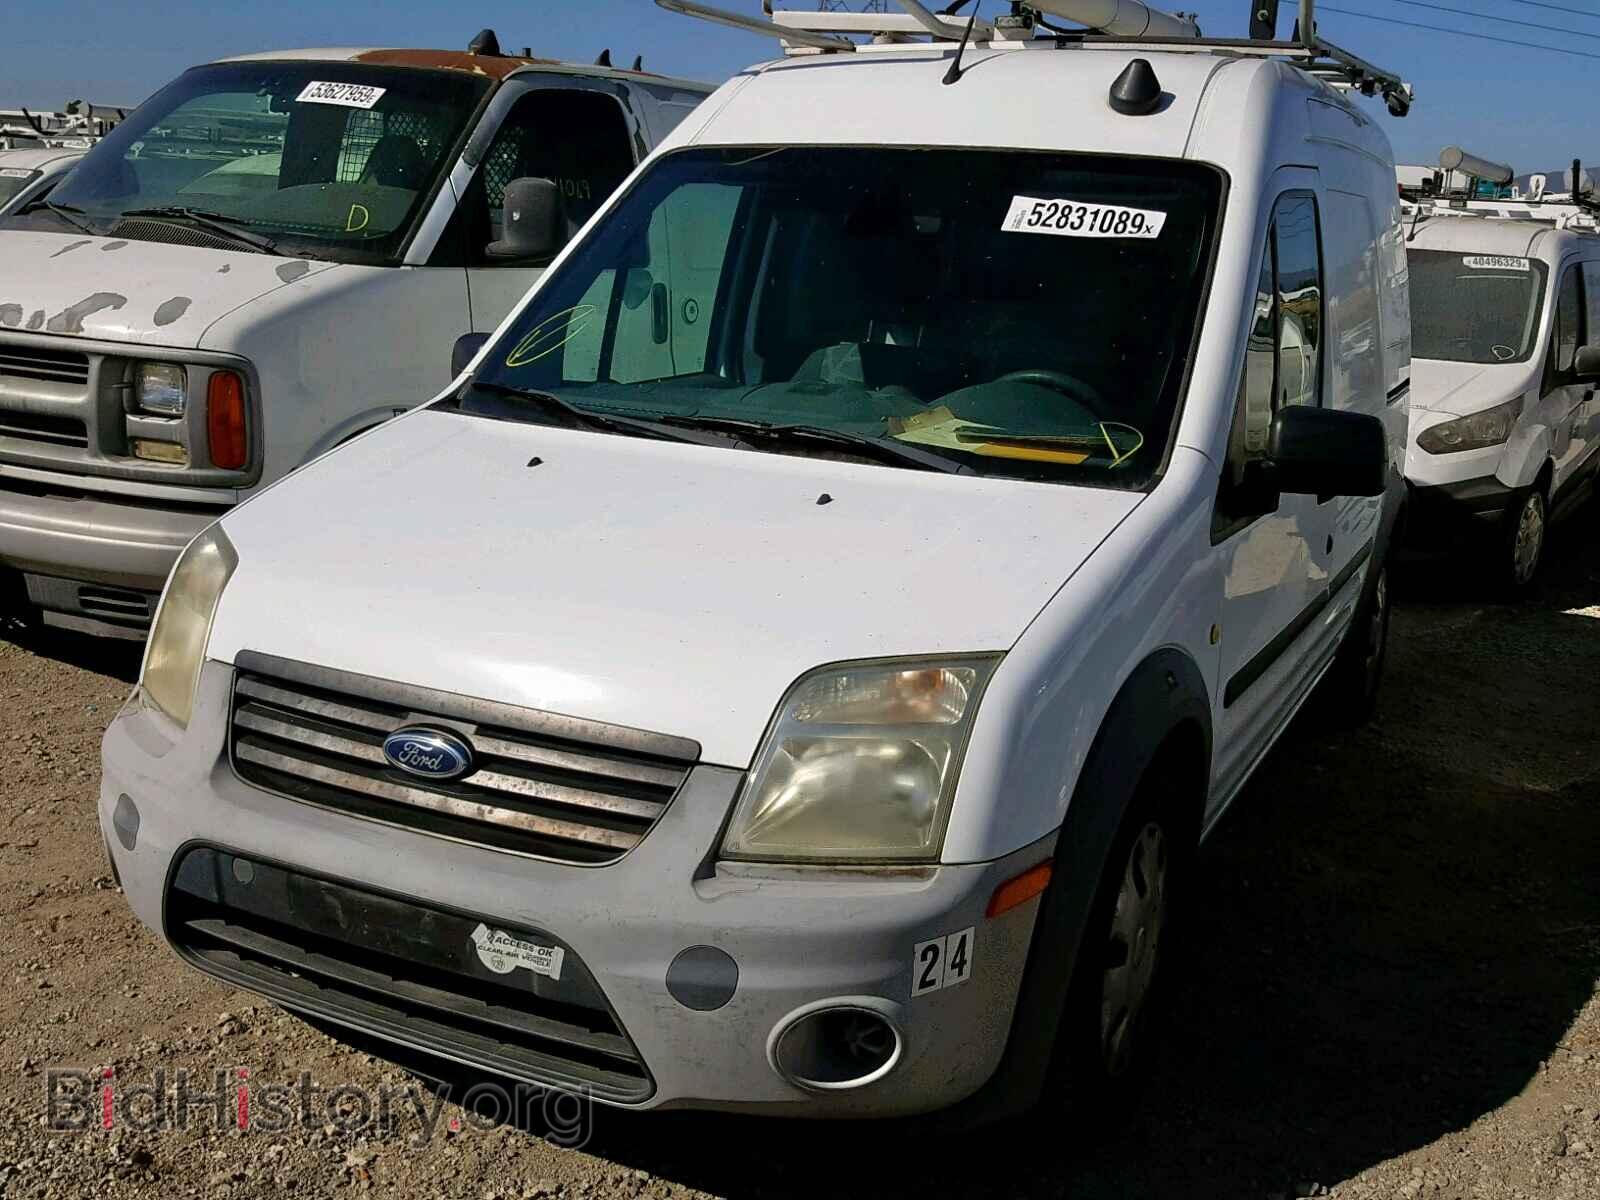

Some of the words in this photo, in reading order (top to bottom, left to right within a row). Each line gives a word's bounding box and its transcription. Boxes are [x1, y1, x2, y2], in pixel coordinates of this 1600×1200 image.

[399, 741, 443, 770] Ford
[495, 936, 535, 953] ACCESS
[537, 948, 554, 957] OK
[918, 933, 968, 990] 24
